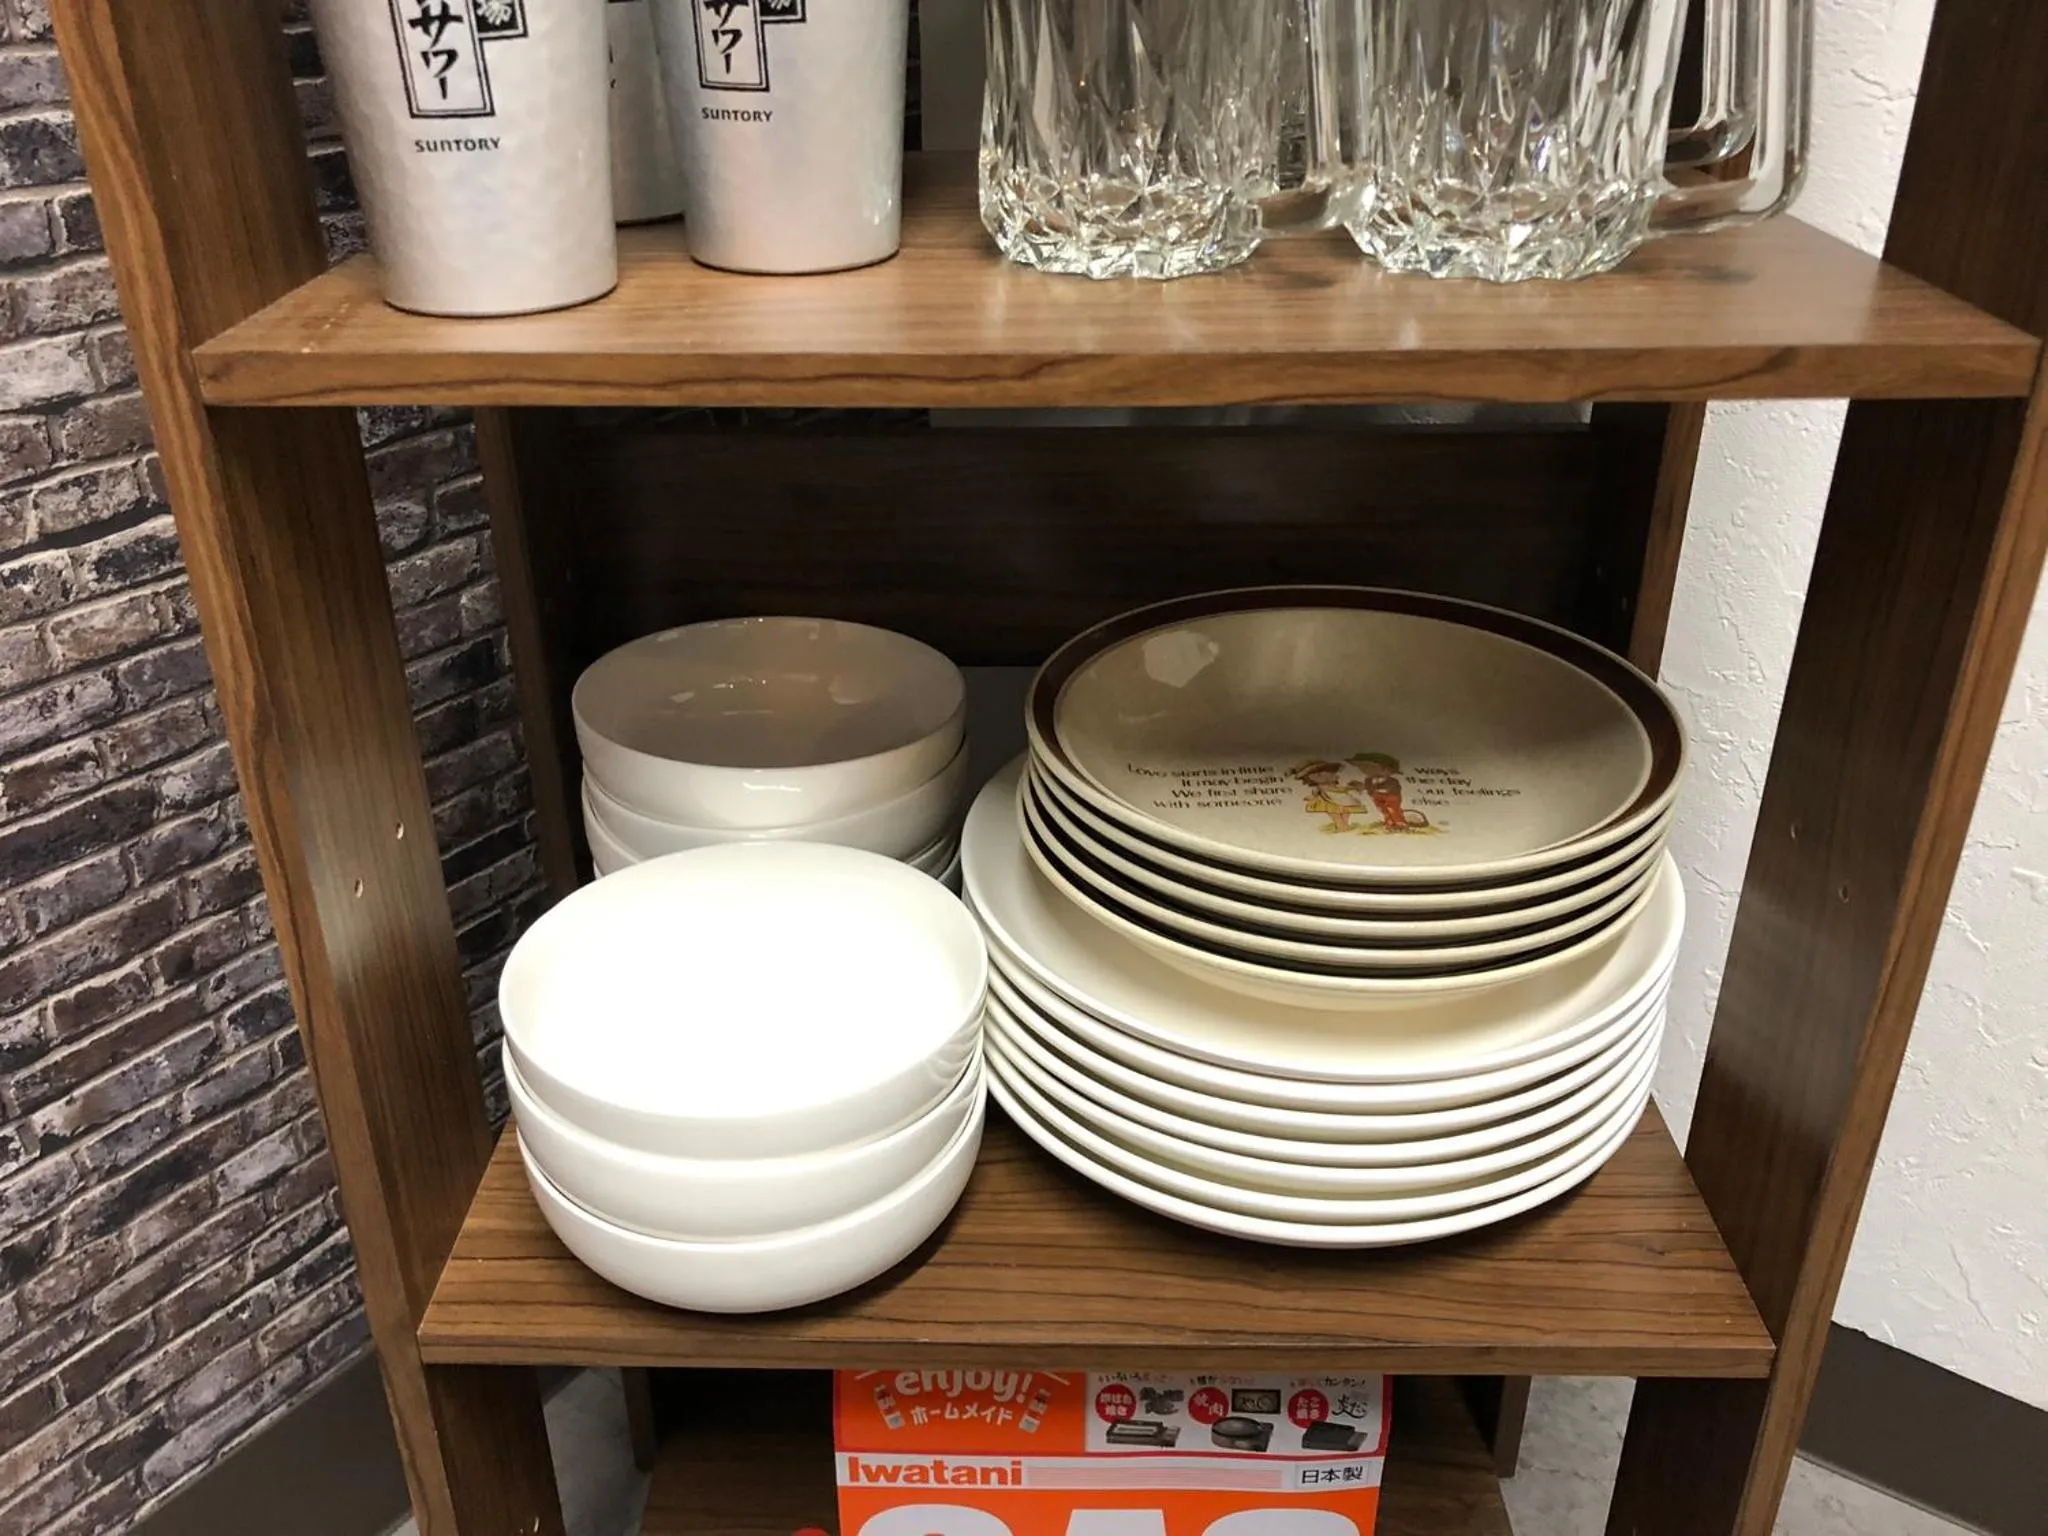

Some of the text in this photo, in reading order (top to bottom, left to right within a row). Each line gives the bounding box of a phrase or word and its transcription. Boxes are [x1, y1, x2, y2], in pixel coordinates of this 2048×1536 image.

[895, 1369, 1033, 1404] enjoy!
[911, 1402, 1014, 1426] ホームメイド
[848, 1456, 1023, 1486] Iwatani
[1301, 1465, 1364, 1485] 日本製
